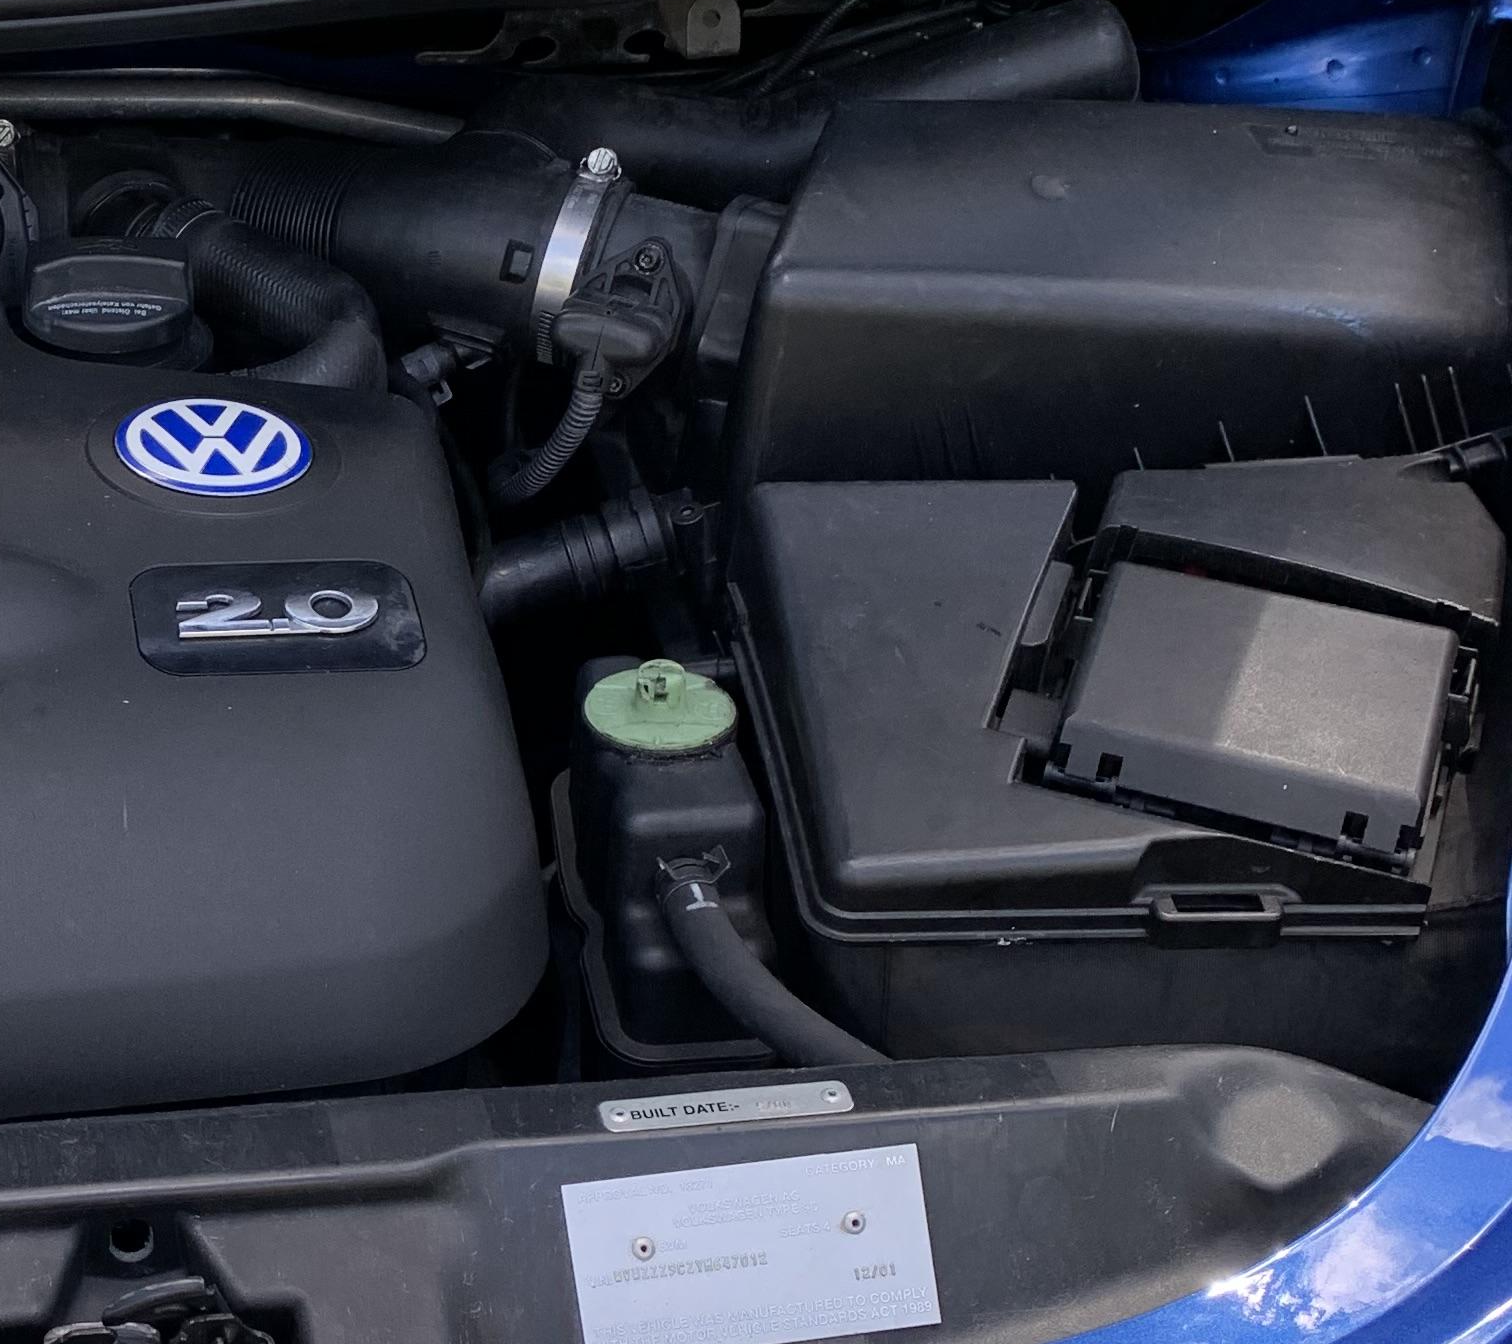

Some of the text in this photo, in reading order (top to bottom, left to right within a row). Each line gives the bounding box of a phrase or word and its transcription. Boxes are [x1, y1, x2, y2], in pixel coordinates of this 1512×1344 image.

[176, 589, 380, 639] 2.0
[630, 1105, 678, 1120] BUILT
[886, 1155, 906, 1169] MA
[848, 1294, 866, 1307] TO
[870, 1286, 929, 1305] COMPLY
[871, 1305, 897, 1320] ACT
